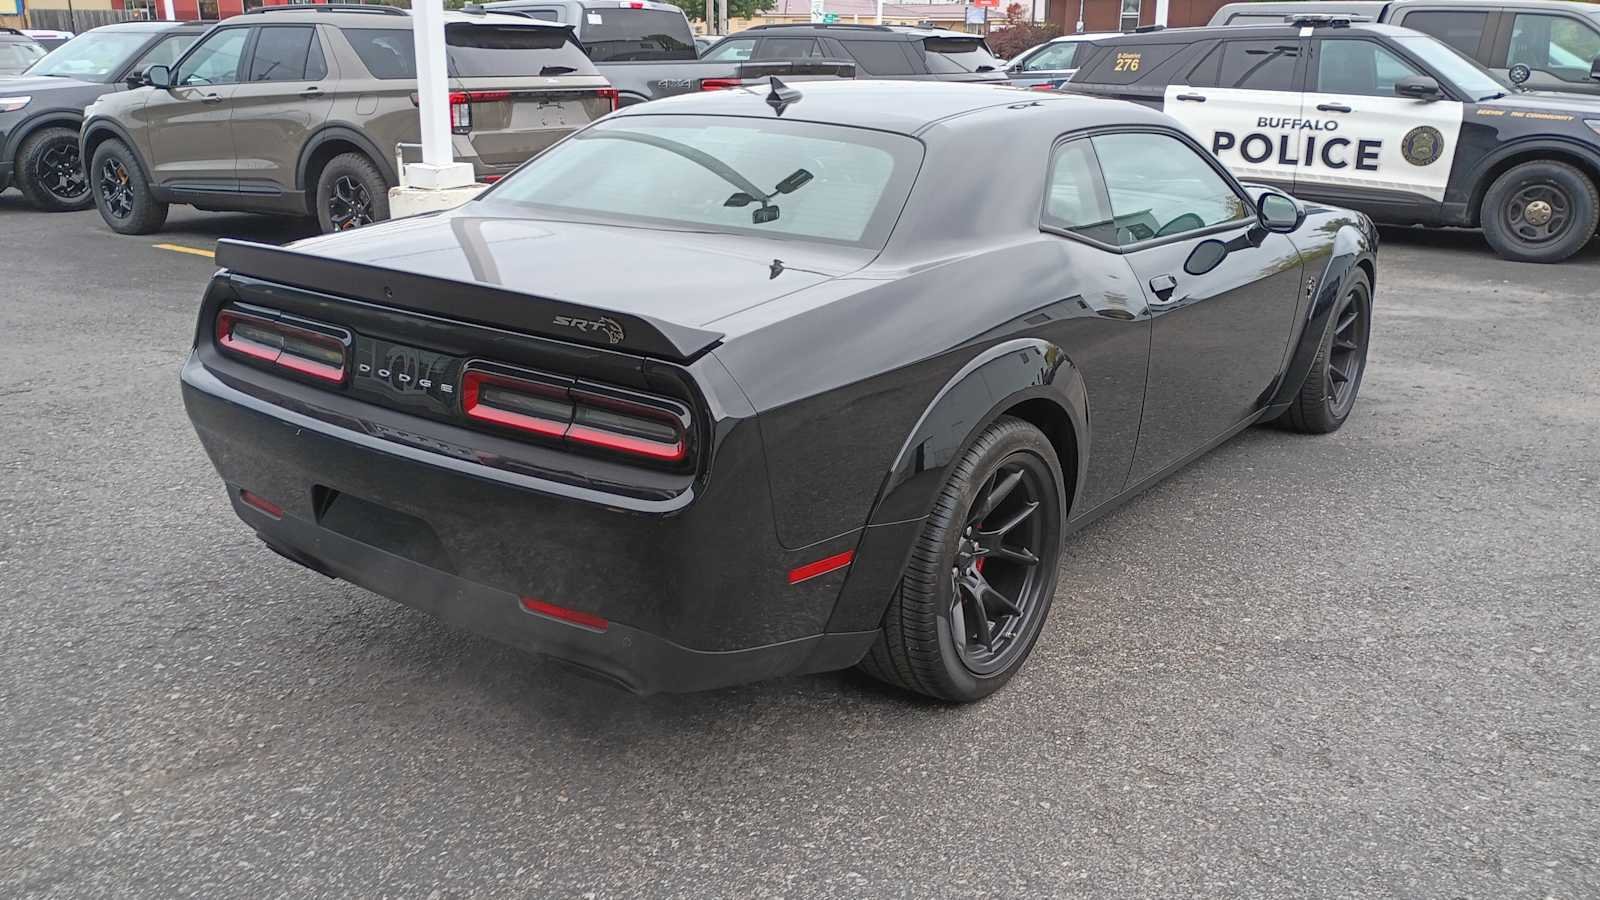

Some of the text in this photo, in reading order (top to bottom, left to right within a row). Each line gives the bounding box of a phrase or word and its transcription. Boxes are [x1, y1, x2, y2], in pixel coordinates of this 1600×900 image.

[1114, 59, 1140, 71] 276
[1257, 116, 1339, 132] BUFFALO
[1212, 131, 1383, 171] POLICE
[552, 315, 607, 332] SRT
[360, 363, 453, 393] DODGE
